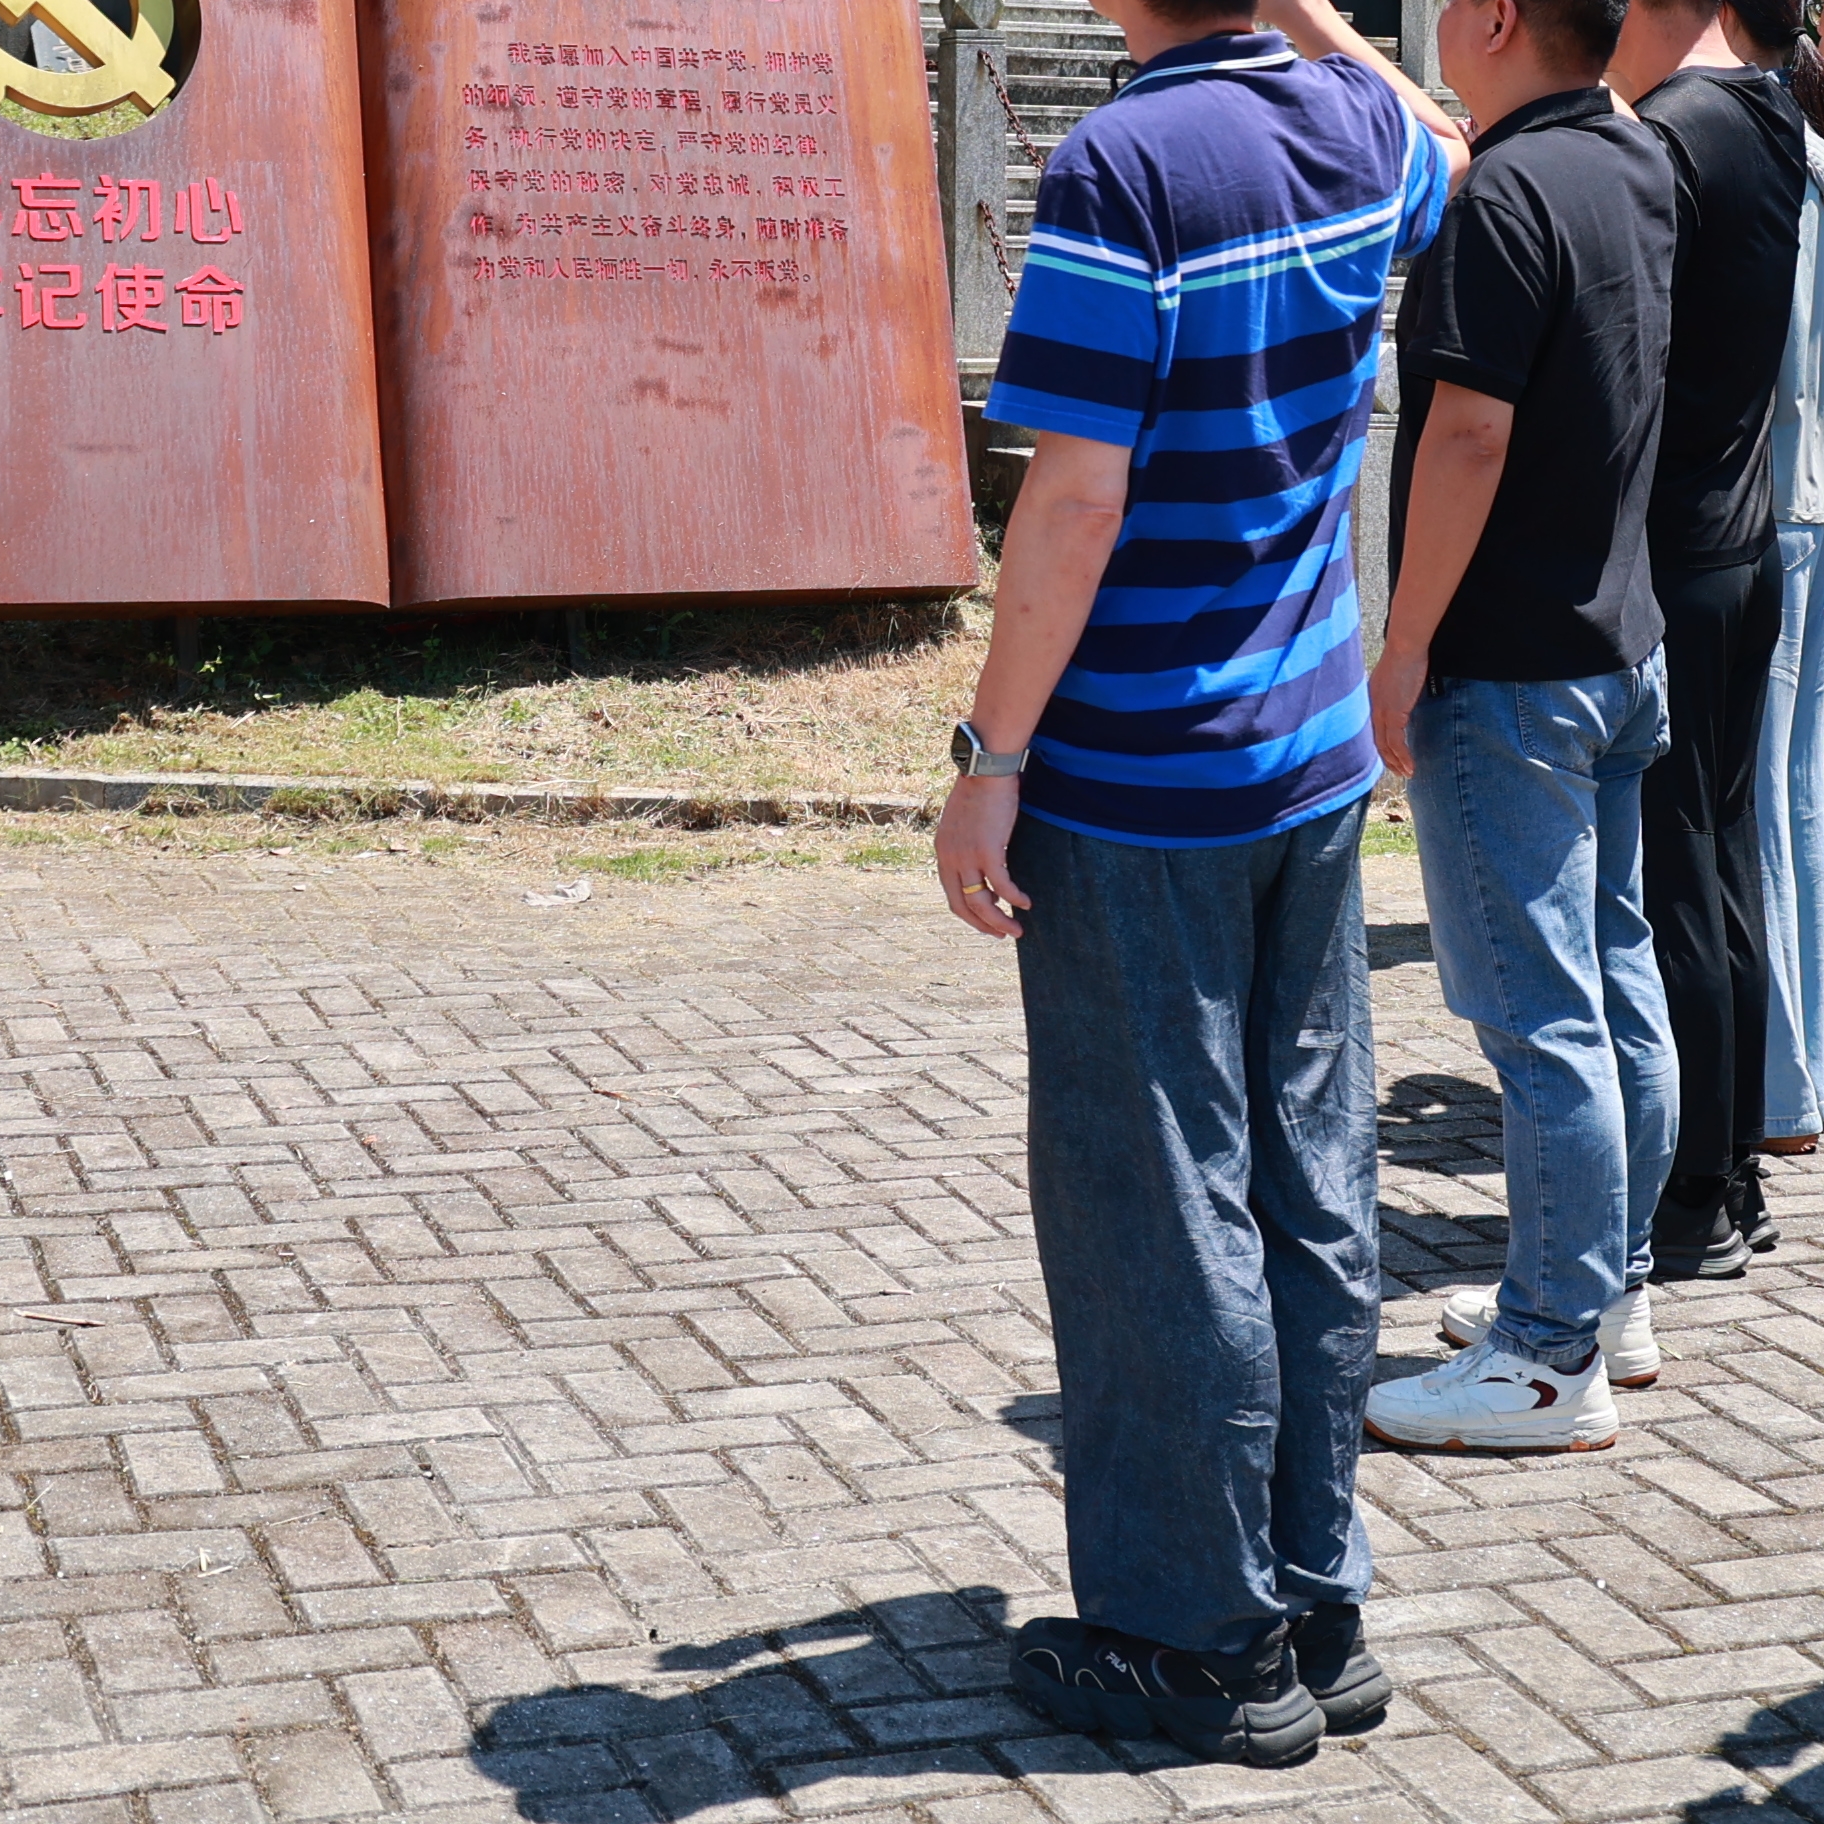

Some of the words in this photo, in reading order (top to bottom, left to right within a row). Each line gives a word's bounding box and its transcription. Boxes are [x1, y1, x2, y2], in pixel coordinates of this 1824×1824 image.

[508, 42, 834, 75] 我志愿加入中国共产党，拥护党
[462, 84, 838, 117] 的纲领，遵守党的章程，履行党员义
[464, 126, 829, 158] 务，执行党的决定，严守党的纪律，
[467, 168, 846, 200] 保守党的秘密，对党忠诚，积极工
